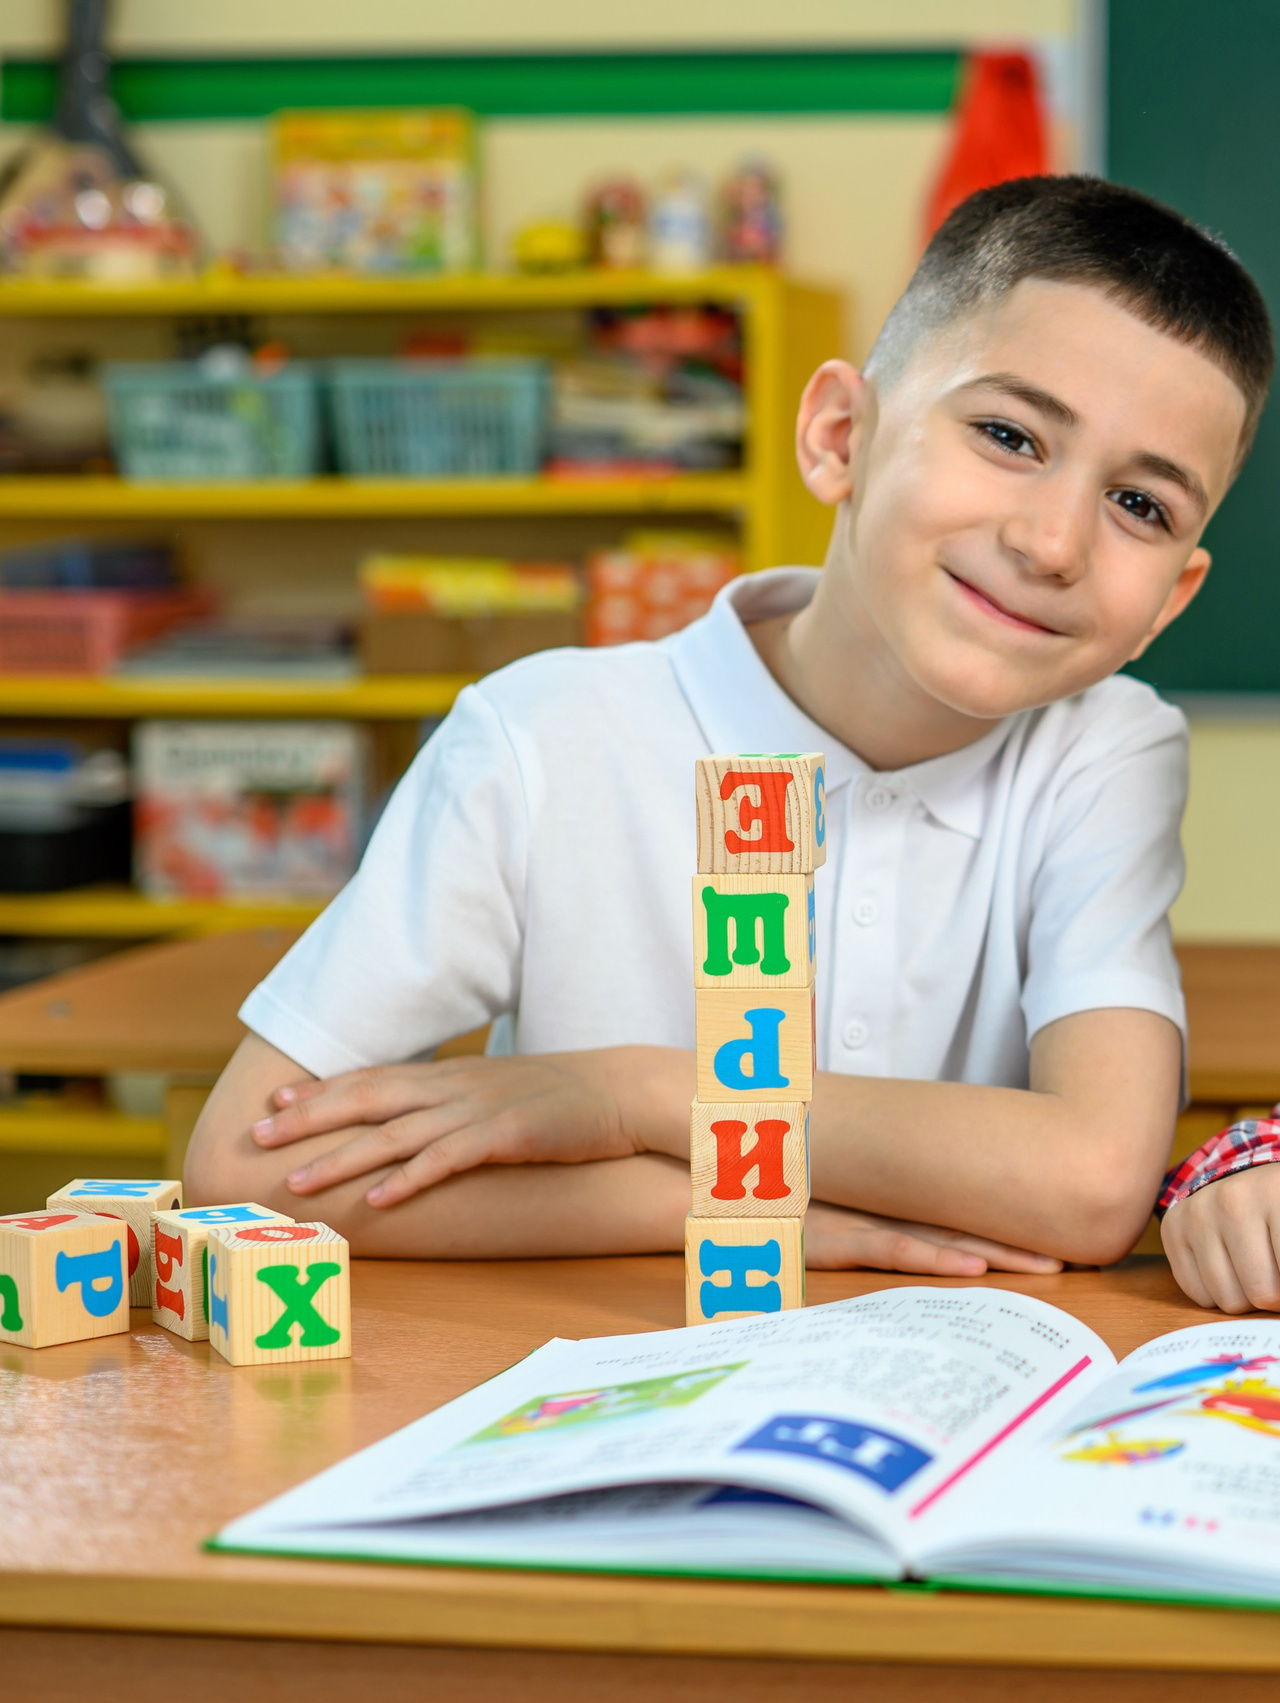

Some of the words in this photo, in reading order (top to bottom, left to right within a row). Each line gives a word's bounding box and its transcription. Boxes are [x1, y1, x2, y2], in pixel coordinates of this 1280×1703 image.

[720, 771, 795, 854] Е
[714, 1008, 789, 1090] Р
[710, 1120, 791, 1201] И
[235, 1226, 320, 1242] О
[56, 1240, 124, 1317] Р
[255, 1262, 341, 1349] Х
[699, 1239, 782, 1319] Н
